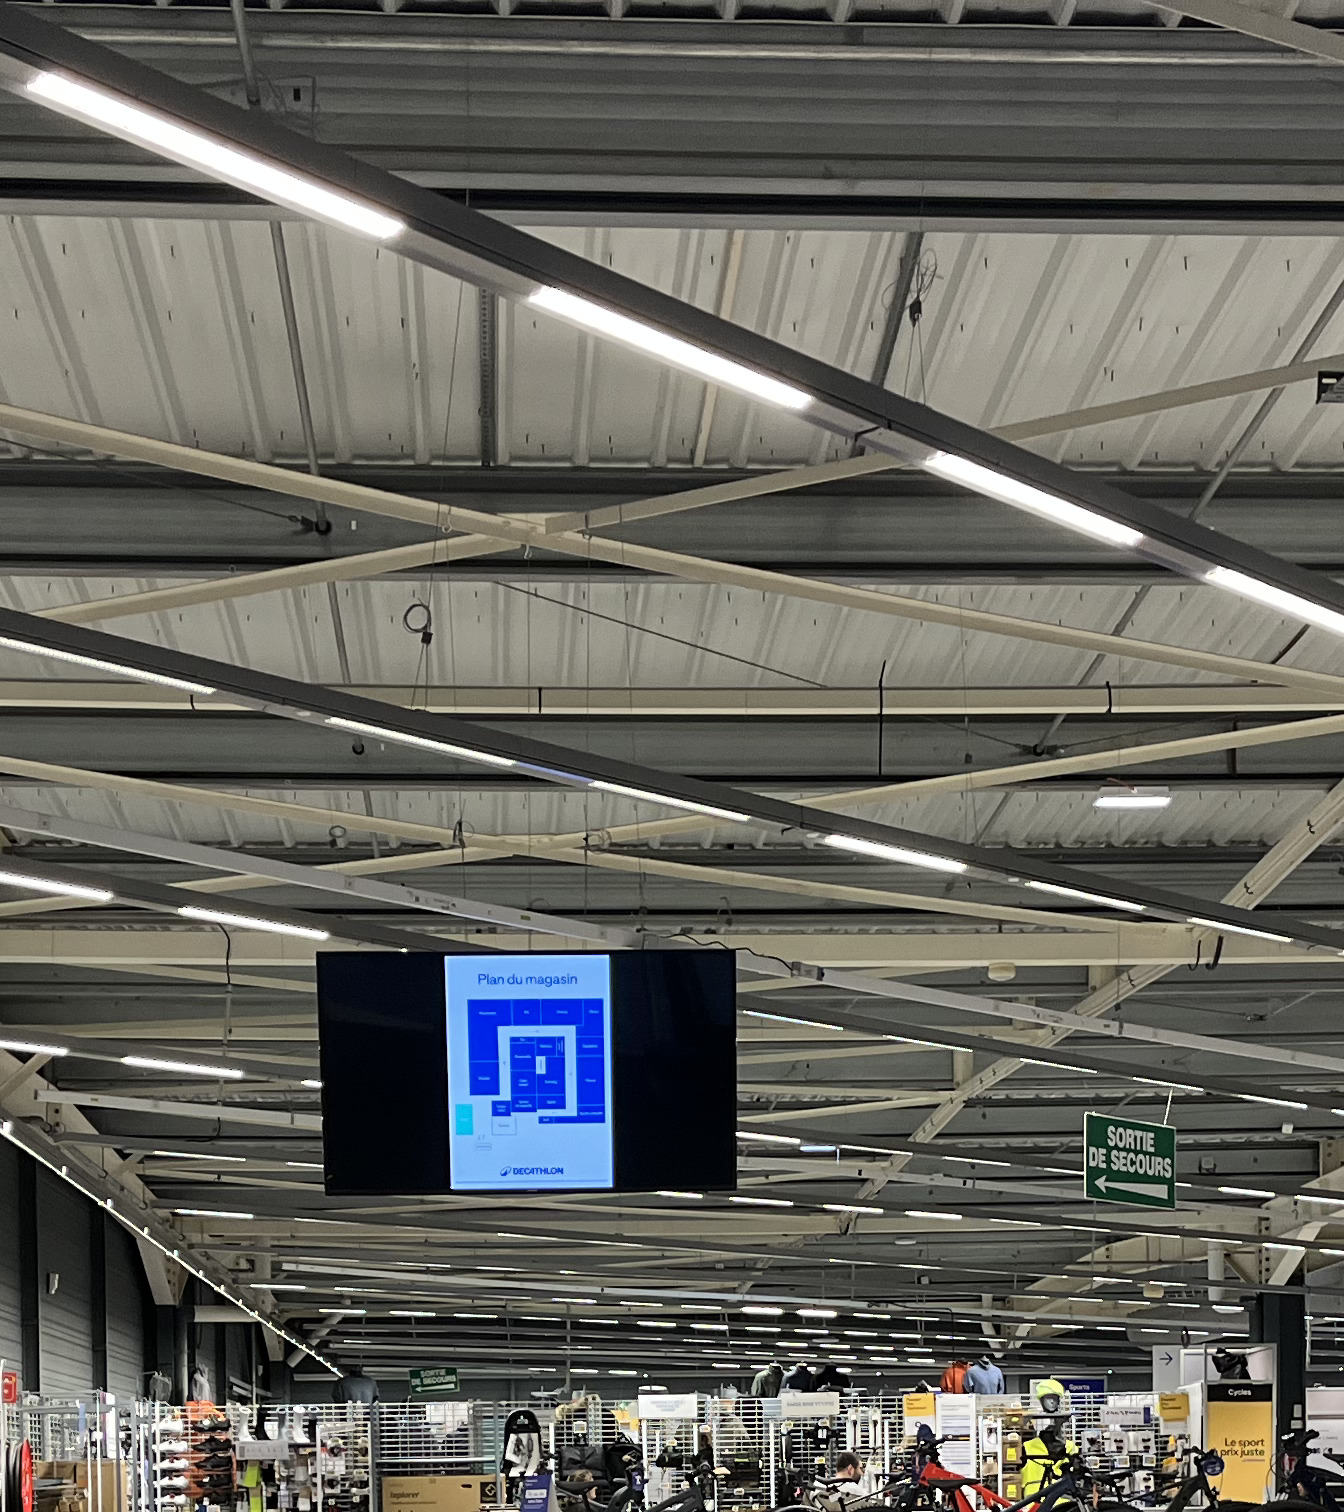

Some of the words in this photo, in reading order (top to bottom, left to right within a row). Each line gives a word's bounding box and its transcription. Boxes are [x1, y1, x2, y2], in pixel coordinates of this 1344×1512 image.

[477, 973, 505, 986] Plan
[506, 973, 523, 986] du
[525, 973, 578, 988] magasin
[1106, 1125, 1156, 1153] SORTIE
[1088, 1146, 1107, 1169] DE
[1110, 1149, 1173, 1179] SECOURS
[512, 1166, 564, 1175] DECATHLON
[1068, 1383, 1091, 1392] Sports
[1227, 1388, 1252, 1397] Cycles
[1224, 1437, 1237, 1447] Le
[1238, 1438, 1265, 1449] sport
[1220, 1447, 1239, 1458] prix
[1239, 1447, 1265, 1459] juste
